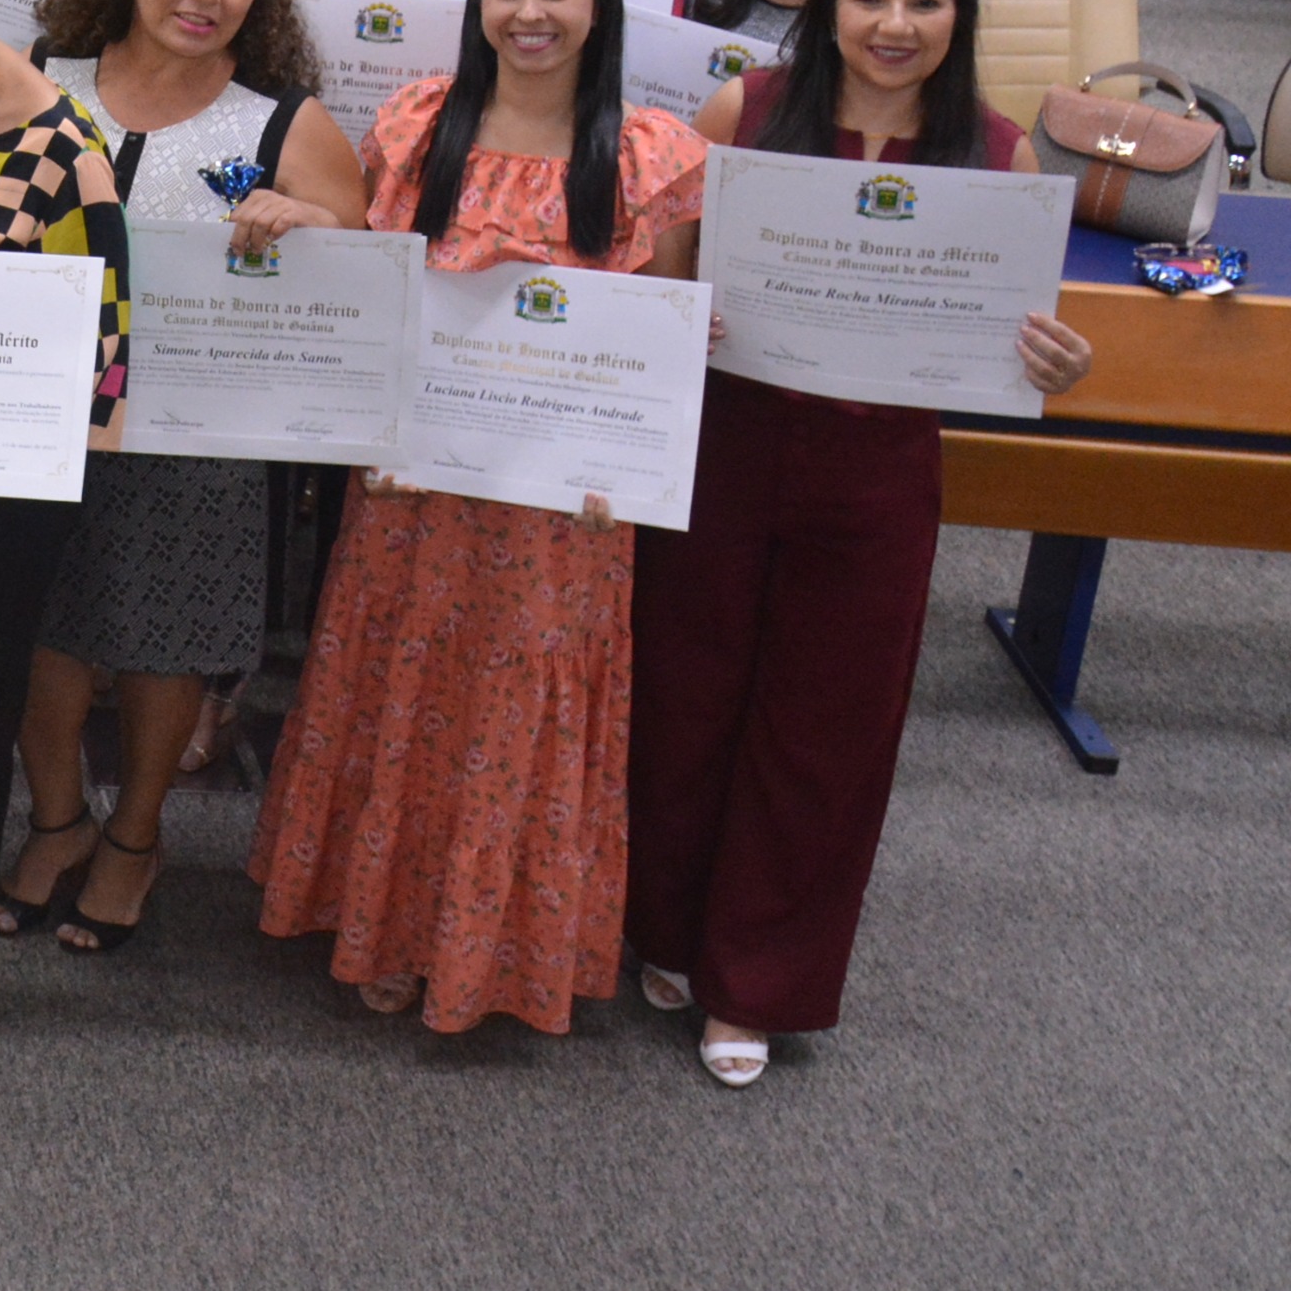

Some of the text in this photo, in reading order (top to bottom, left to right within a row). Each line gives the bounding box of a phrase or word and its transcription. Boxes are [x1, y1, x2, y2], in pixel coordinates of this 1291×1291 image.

[758, 227, 1000, 265] Diploma de Honra ao Mérito
[782, 250, 832, 268] Câmara
[835, 257, 899, 277] Municipal
[902, 263, 916, 276] de
[919, 263, 971, 279] Goiânia
[140, 292, 360, 320] Diploma de Honra ao Mérito
[764, 277, 984, 312] Edivane Rocha Miranda Souza
[163, 313, 335, 334] Câmara Municipal de Goiânia
[152, 343, 343, 366] Simone Aparecida dos Santos
[431, 330, 646, 373] Diploma de Honra ao Mérito
[424, 381, 476, 400] Luciana
[520, 394, 586, 415] Rodrigues
[591, 404, 645, 424] Andrade
